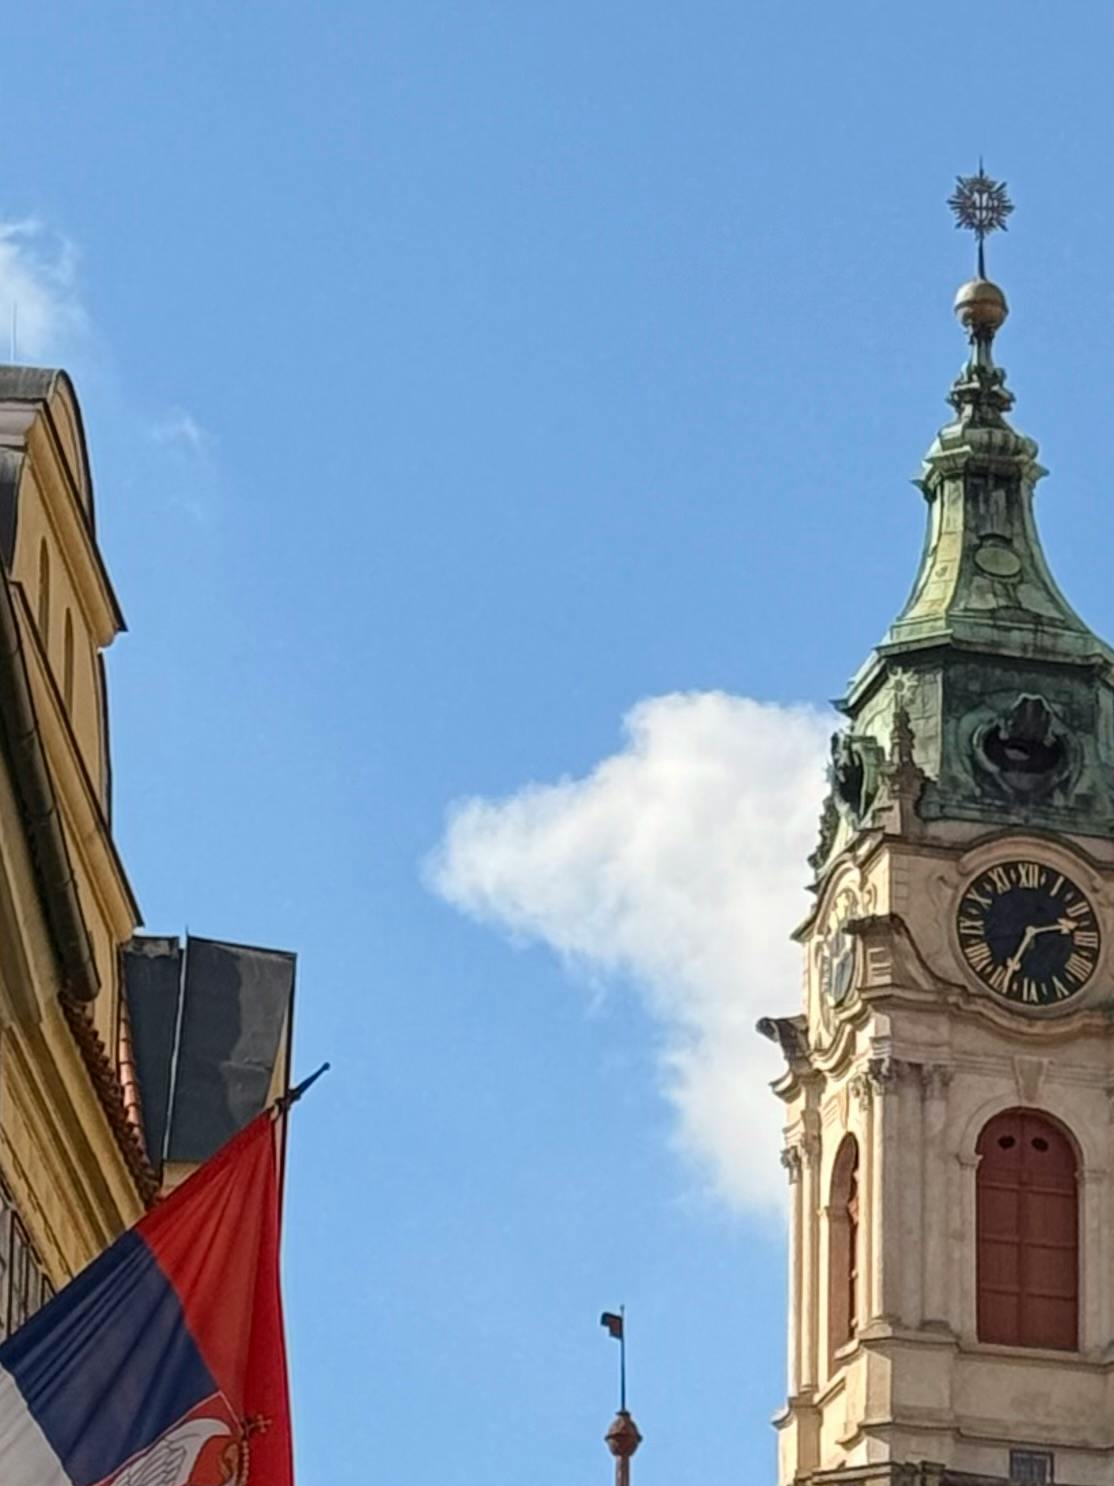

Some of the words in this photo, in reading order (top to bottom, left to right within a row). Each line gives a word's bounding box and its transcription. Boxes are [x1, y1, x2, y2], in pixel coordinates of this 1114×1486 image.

[987, 866, 1011, 895] XI
[1018, 863, 1039, 888] XII
[966, 887, 993, 910] X
[1066, 901, 1090, 918] II
[959, 917, 984, 936] IX
[1073, 930, 1098, 949] III
[1023, 977, 1039, 1003] VI
[1052, 975, 1070, 999] V
